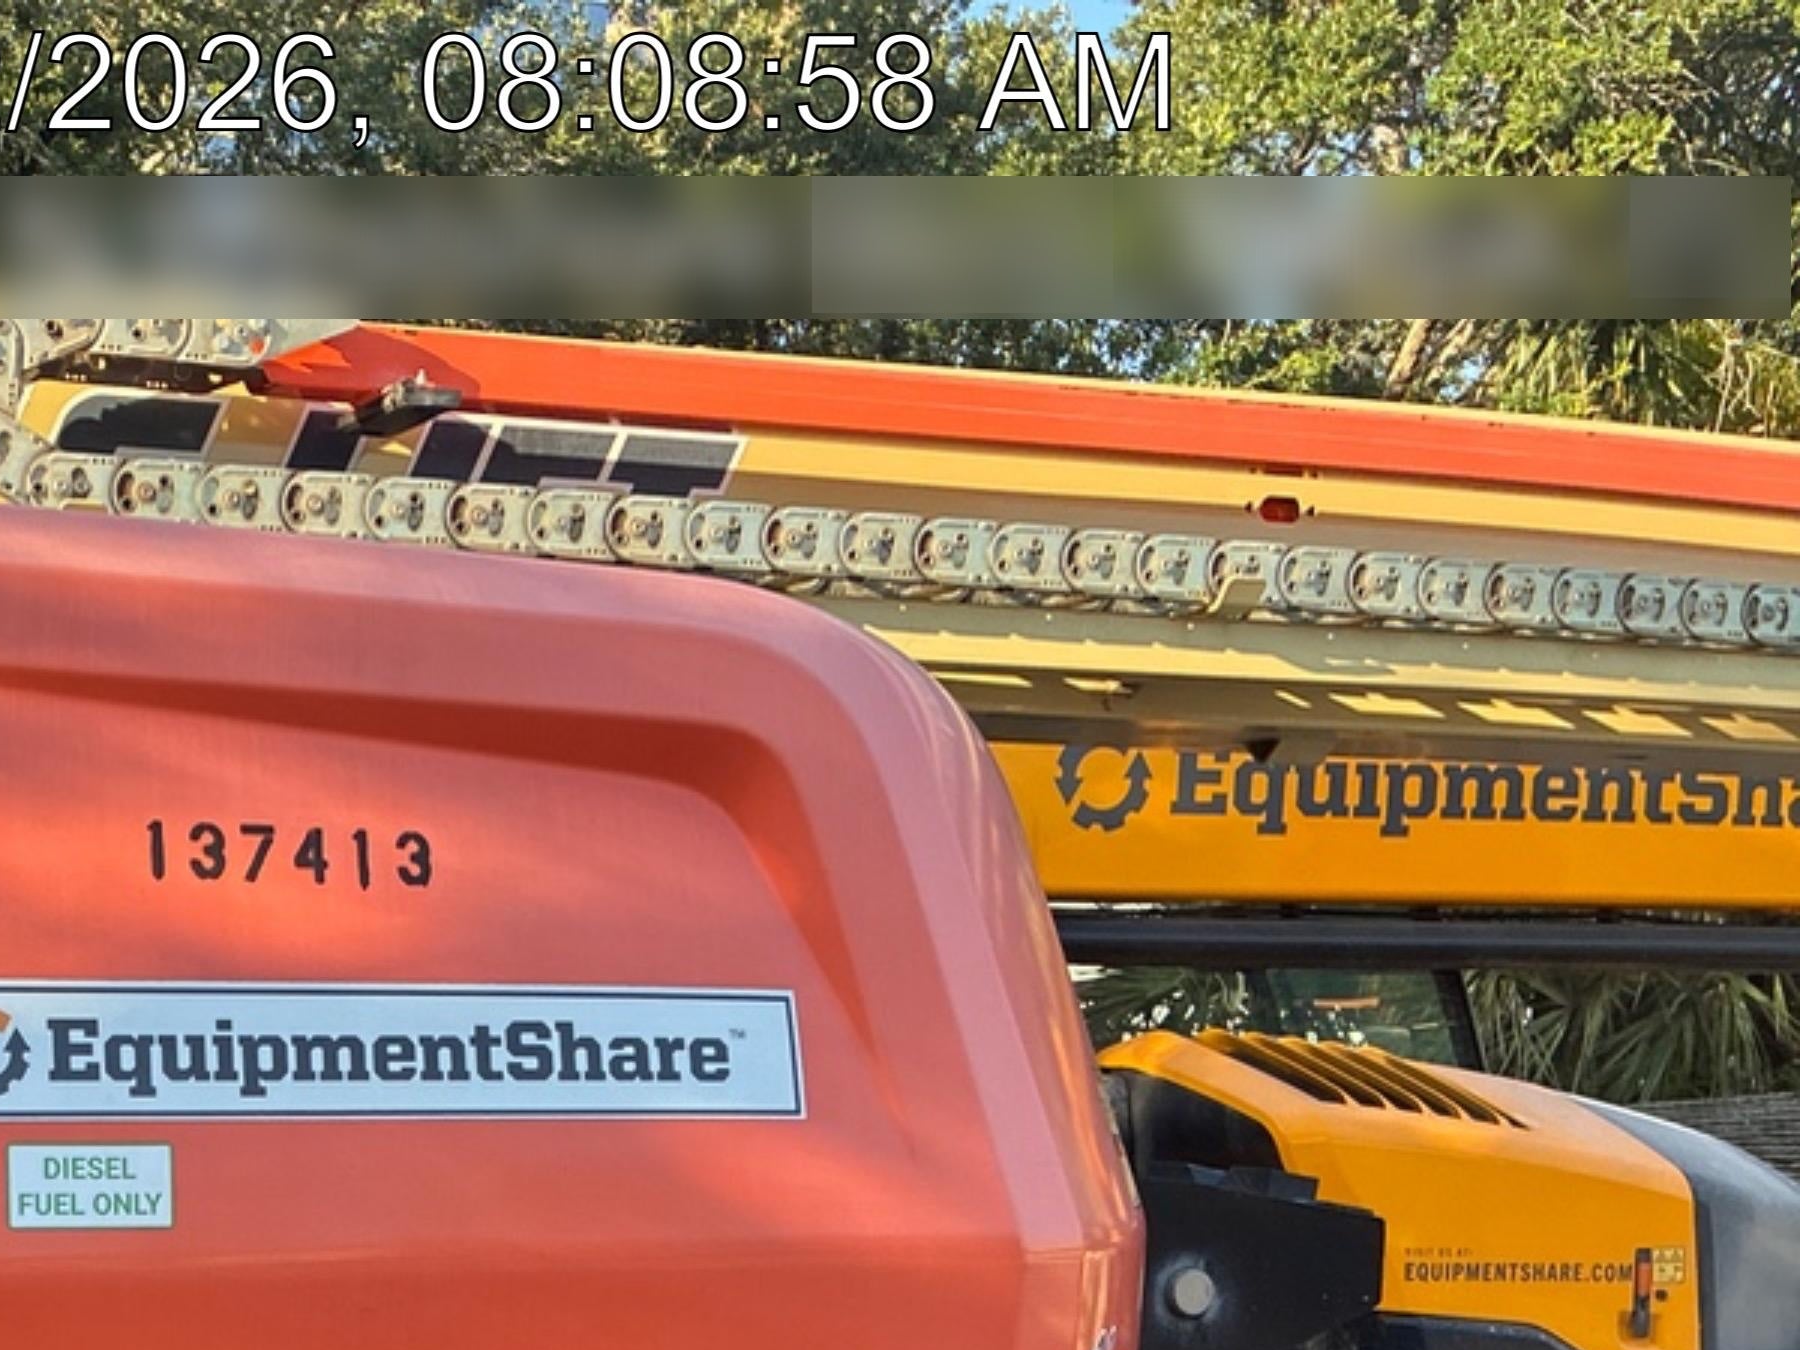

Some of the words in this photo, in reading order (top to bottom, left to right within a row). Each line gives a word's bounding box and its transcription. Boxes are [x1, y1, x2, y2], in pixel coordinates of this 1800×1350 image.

[146, 820, 433, 889] 137413
[47, 1018, 731, 1098] EquipmentShare
[42, 1156, 136, 1181] DIESEL
[18, 1192, 85, 1217] FUEL
[92, 1191, 162, 1217] ONLY
[1404, 1262, 1633, 1282] EQUIPMENTSHARE.COM
